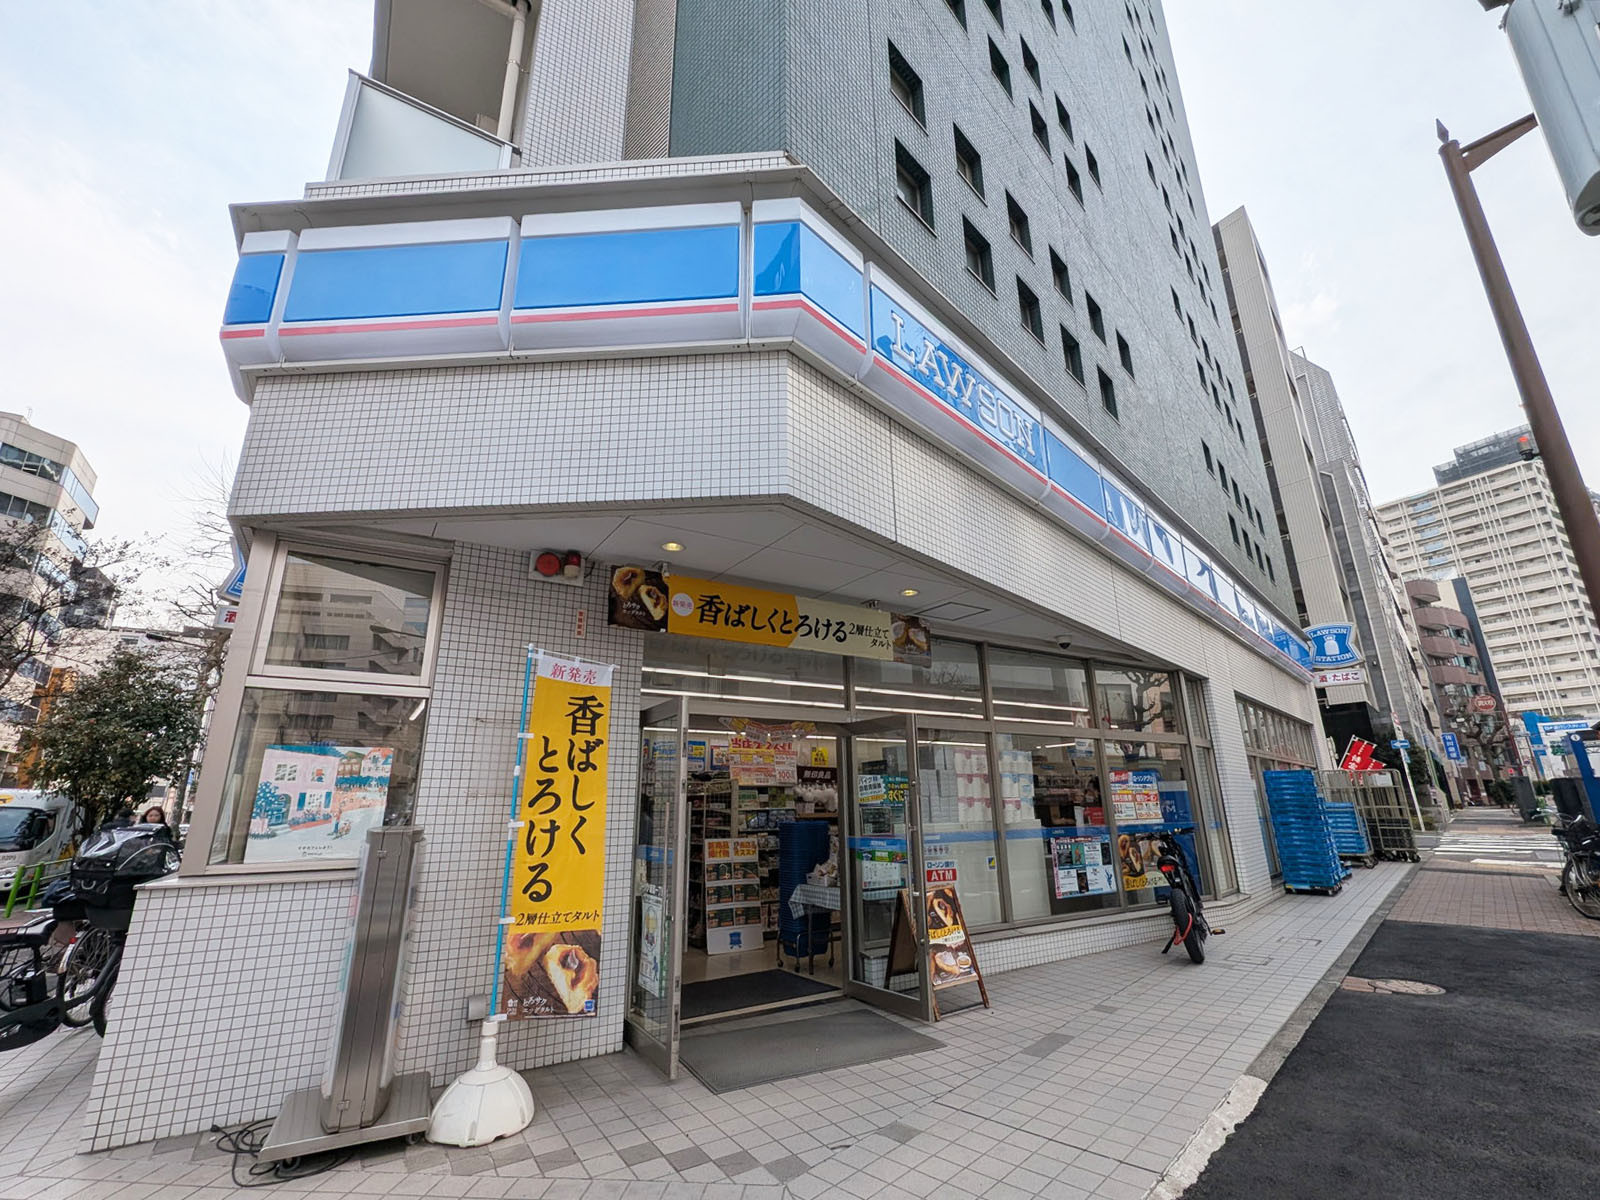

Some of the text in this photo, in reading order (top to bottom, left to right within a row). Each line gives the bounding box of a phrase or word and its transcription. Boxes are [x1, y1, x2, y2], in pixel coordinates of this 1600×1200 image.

[891, 310, 1035, 456] LAWSON
[696, 594, 848, 643] 香ばしくとろける
[849, 623, 889, 639] 2層仕立て
[1311, 628, 1348, 638] LAWSON
[868, 638, 892, 650] タルト
[1315, 652, 1353, 662] STATION
[551, 663, 597, 685] 新発売
[565, 695, 604, 855] 香ばしく
[522, 735, 561, 903] とろける
[931, 870, 953, 881] ATM
[516, 910, 600, 926] 2層仕立てタルト
